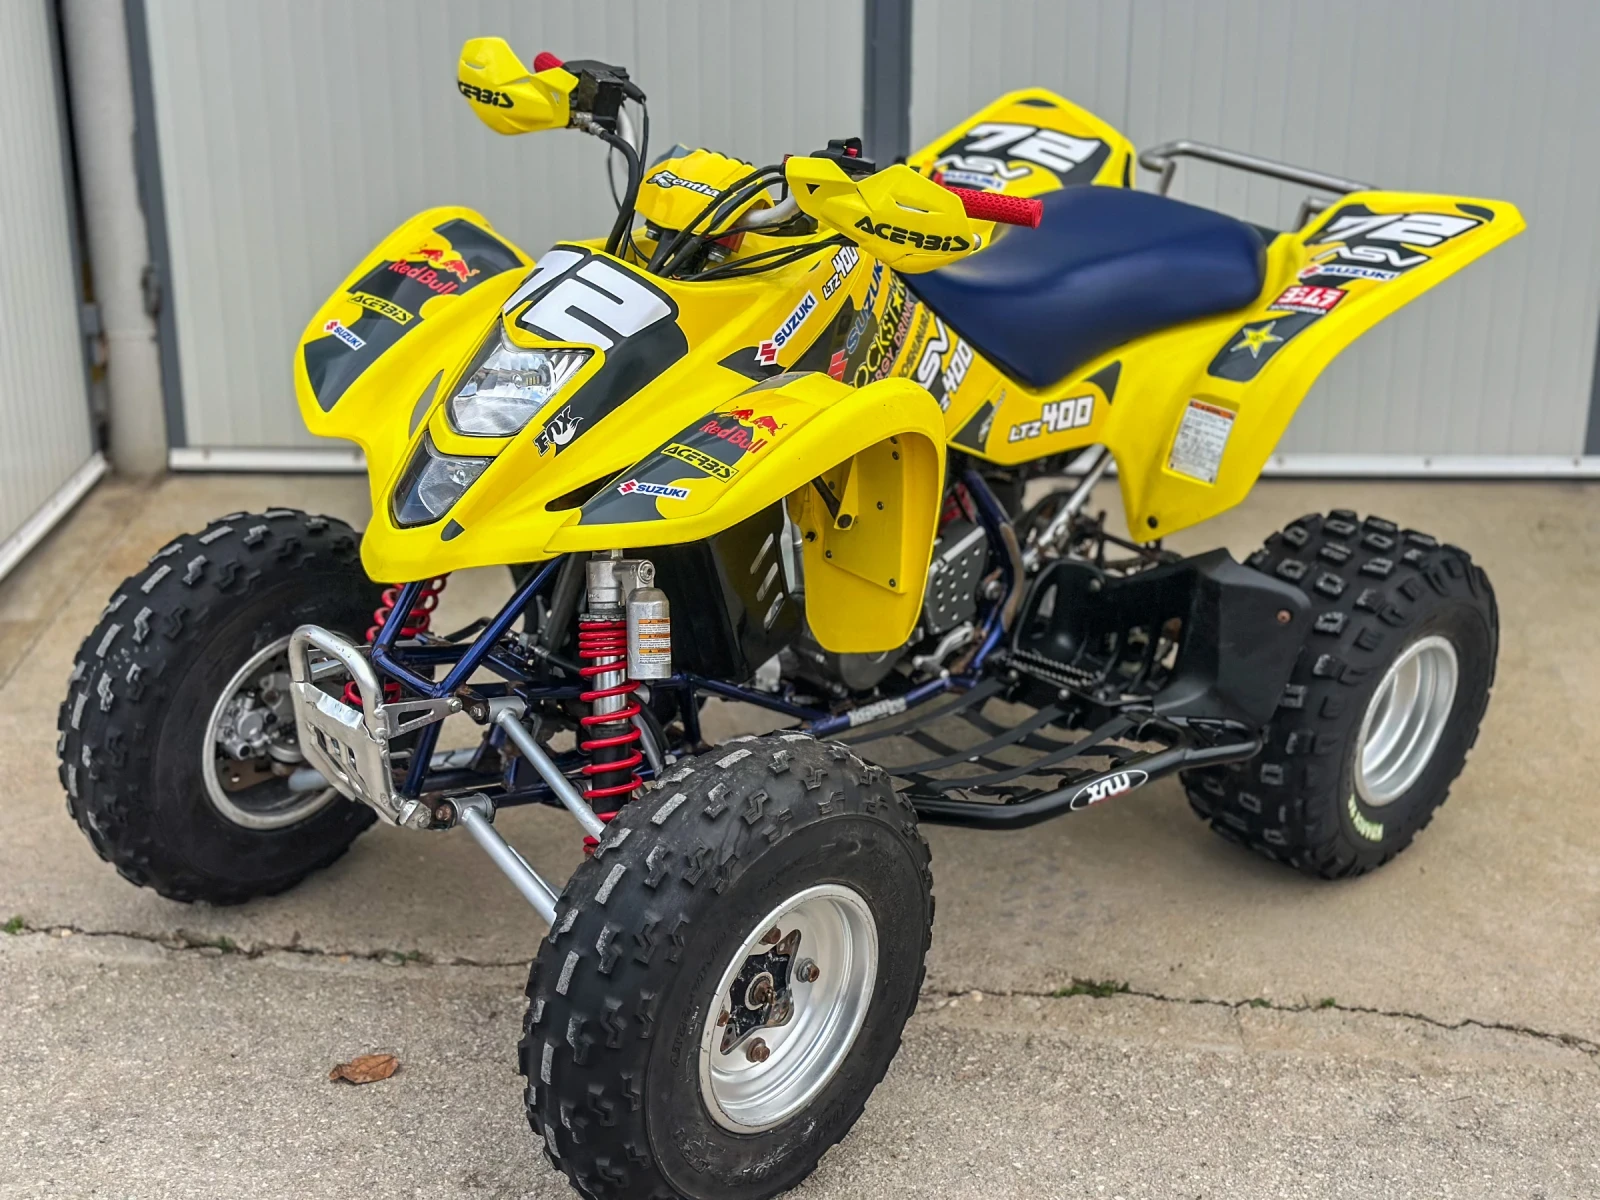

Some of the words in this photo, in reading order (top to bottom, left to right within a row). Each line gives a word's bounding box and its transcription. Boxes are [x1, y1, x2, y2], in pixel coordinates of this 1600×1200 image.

[457, 80, 515, 109] CERBIS
[964, 123, 1101, 173] 72
[646, 169, 721, 197] Rentha
[854, 215, 970, 252] ACERBIS
[1319, 213, 1480, 247] 72
[1310, 245, 1429, 267] ASV
[1322, 266, 1397, 281] SUZUKI
[773, 294, 817, 347] SUZUKI
[333, 326, 364, 349] SUZUKI
[532, 404, 574, 457] FOX
[664, 445, 732, 480] ACERBIS
[636, 484, 689, 499] SUZUKI
